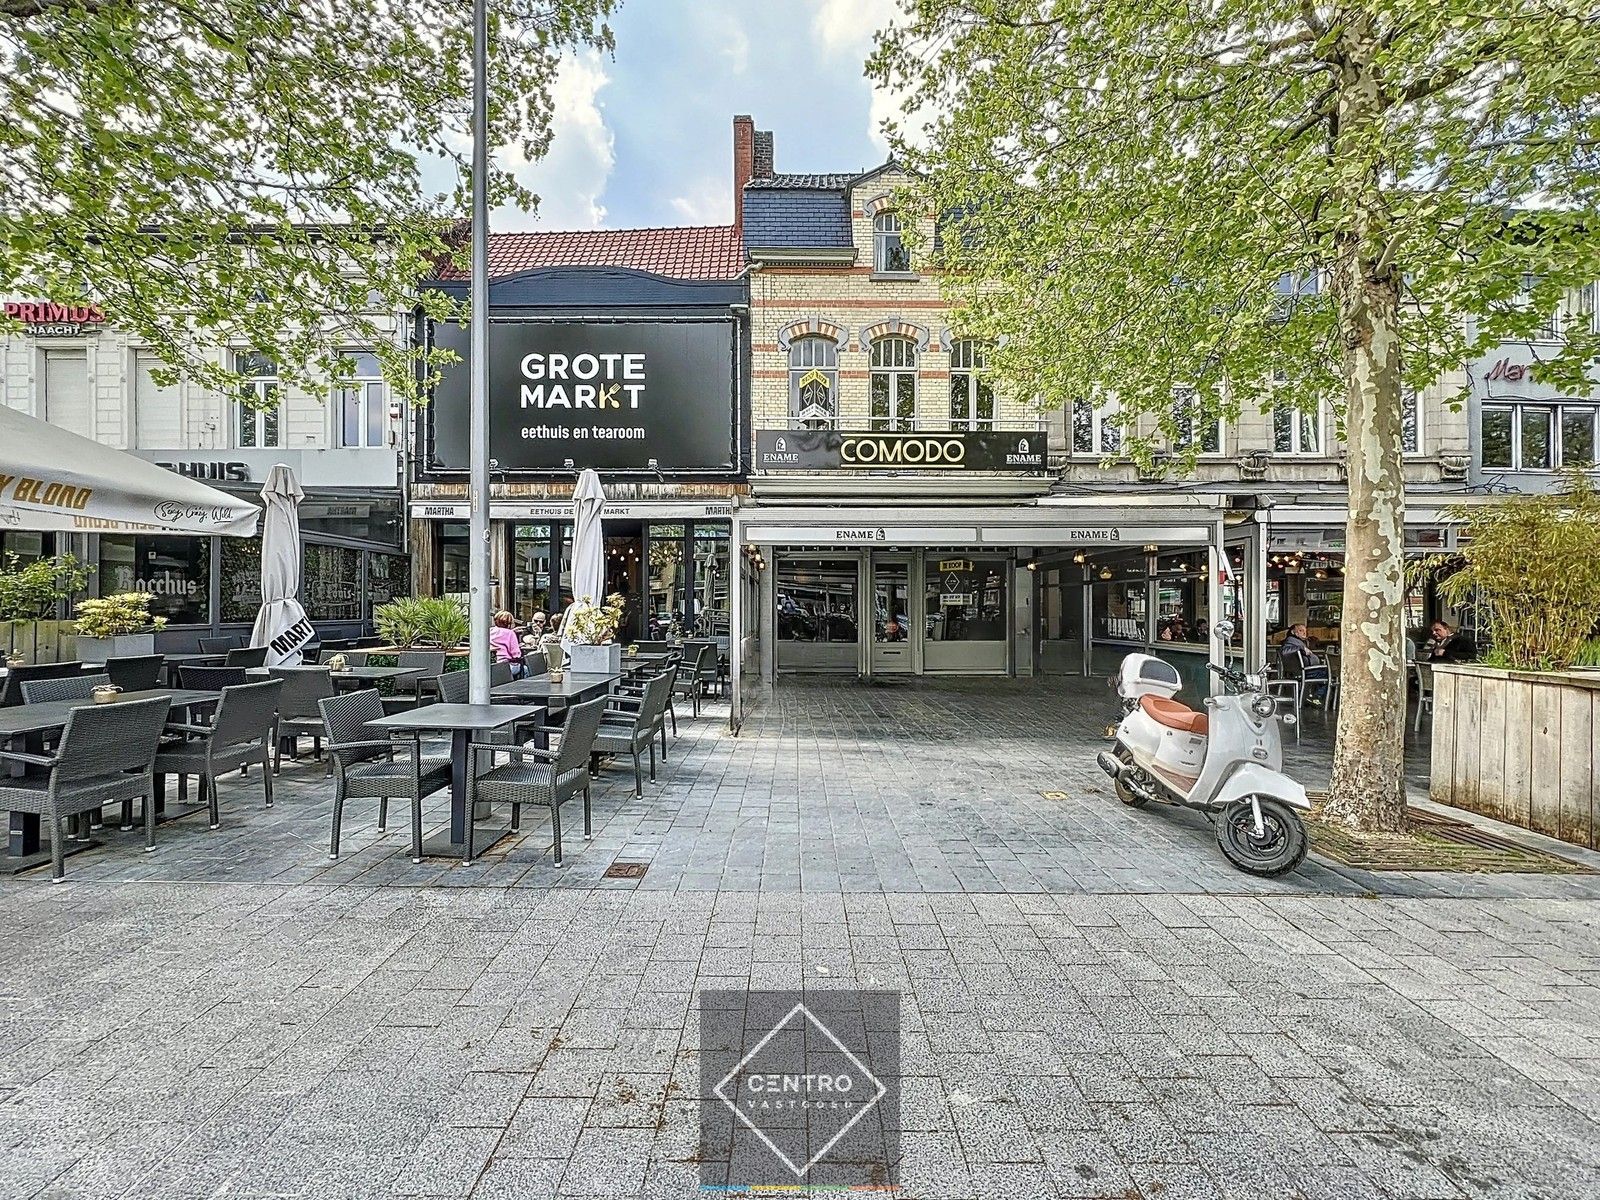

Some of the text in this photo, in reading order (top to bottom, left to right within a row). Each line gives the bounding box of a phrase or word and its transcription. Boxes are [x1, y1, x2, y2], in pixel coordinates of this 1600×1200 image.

[4, 302, 106, 323] PRIMUS
[27, 325, 81, 335] HAACHT
[520, 353, 646, 380] GROTE
[520, 382, 646, 409] MARKT
[521, 424, 645, 439] eethuis en tearoom
[840, 439, 965, 463] COMODO
[763, 453, 799, 461] ENAME
[1006, 454, 1042, 462] ENAME
[424, 506, 455, 516] MARTHA
[705, 506, 731, 515] MARTH
[836, 530, 874, 539] ENAME
[1070, 530, 1108, 539] ENAME
[269, 616, 312, 657] MART
